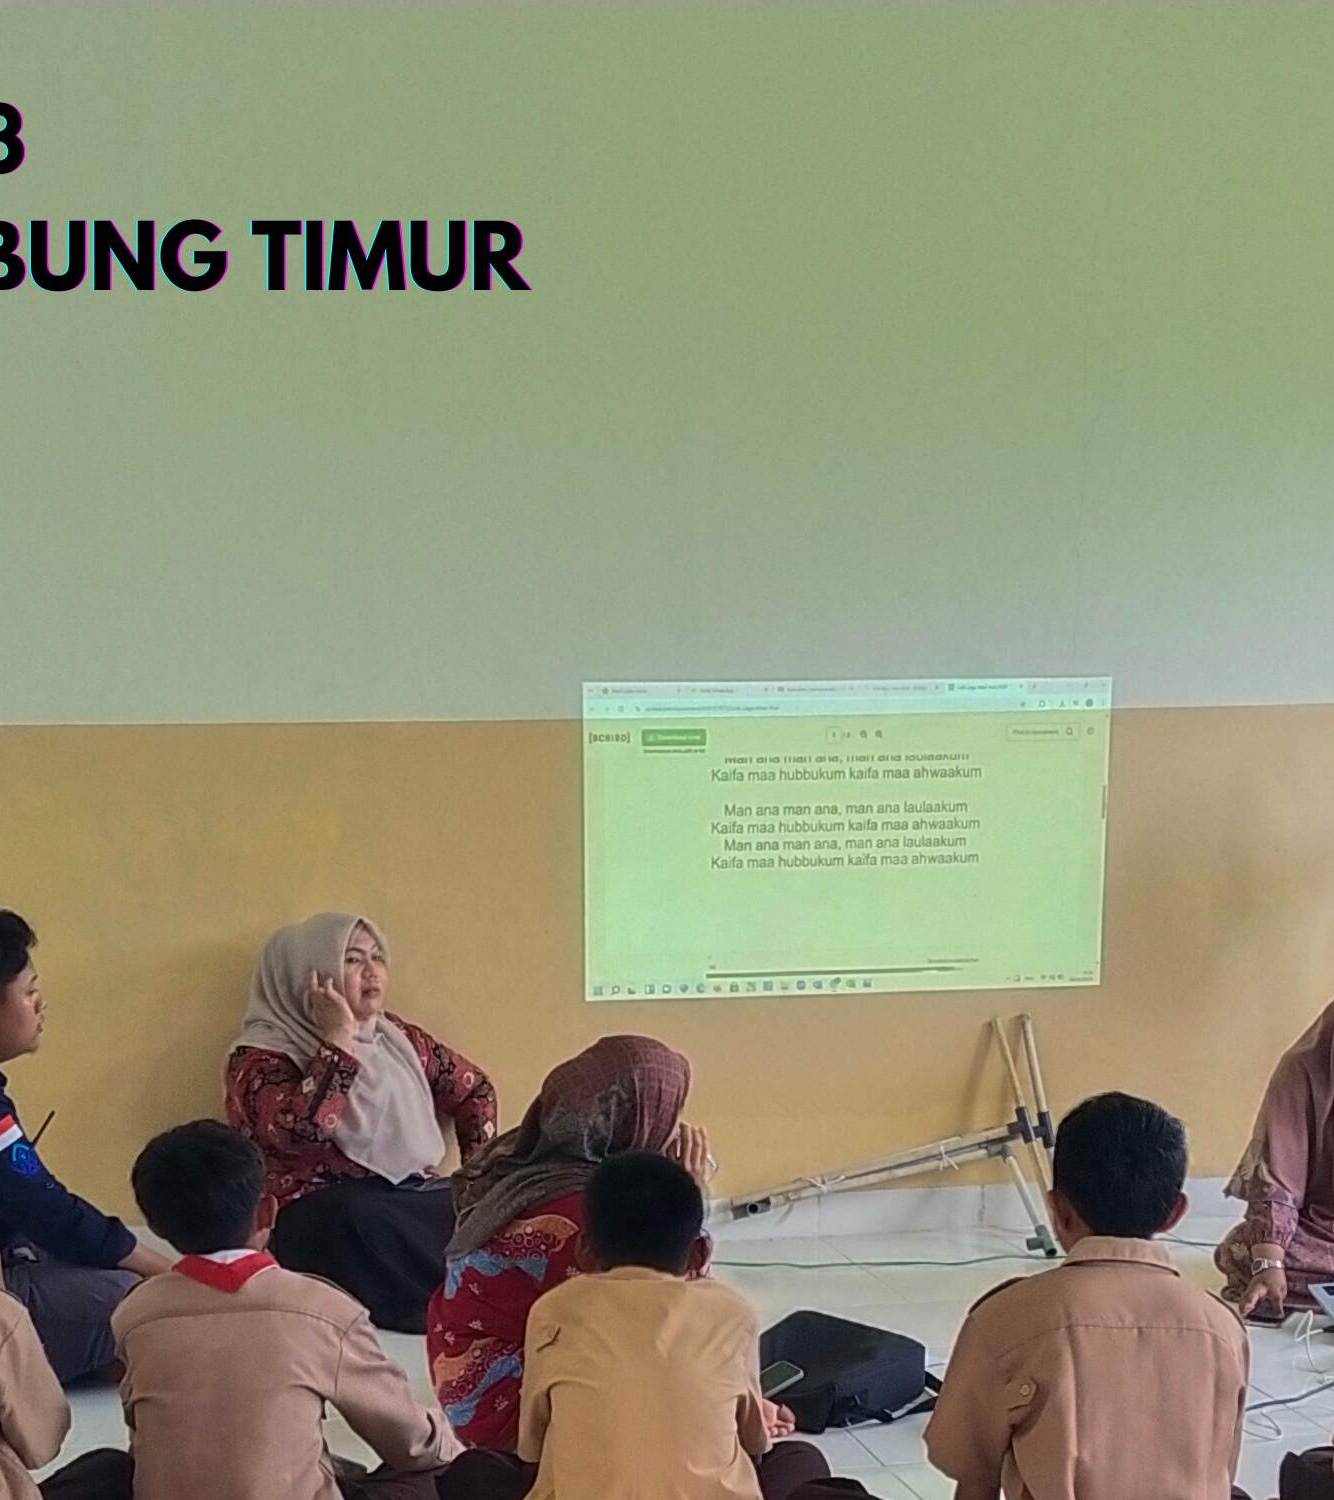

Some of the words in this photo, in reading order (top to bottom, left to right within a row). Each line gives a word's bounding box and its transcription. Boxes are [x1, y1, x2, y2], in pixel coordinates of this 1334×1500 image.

[711, 768, 744, 782] Kaifa
[748, 770, 776, 781] maa
[779, 767, 846, 781] hubbukum
[849, 766, 879, 780] kaifa
[883, 768, 910, 779] maa
[913, 765, 982, 779] ahwaakum
[724, 803, 753, 817] Man
[755, 805, 780, 817] ana
[783, 805, 812, 816] man
[814, 804, 842, 817] ana,
[846, 804, 874, 815] man
[876, 803, 900, 814] ana
[904, 800, 968, 814] laulaakum
[711, 821, 744, 835] Kaifa
[747, 823, 776, 834] maa
[779, 820, 845, 834] hubbukum
[848, 818, 878, 832] kaifa
[881, 820, 909, 831] maa
[912, 817, 981, 831] ahwaakum
[724, 839, 752, 852] Man
[755, 840, 780, 852] ana
[783, 840, 811, 851] man
[814, 839, 842, 852] ana,
[845, 838, 873, 849] man
[876, 838, 900, 849] ana
[903, 835, 967, 849] laulaakum
[711, 856, 744, 870] Kaifa
[747, 858, 775, 869] maa
[778, 855, 845, 869] hubbukum
[847, 853, 878, 867] kaifa
[881, 855, 909, 866] maa
[911, 852, 980, 866] ahwaakum
